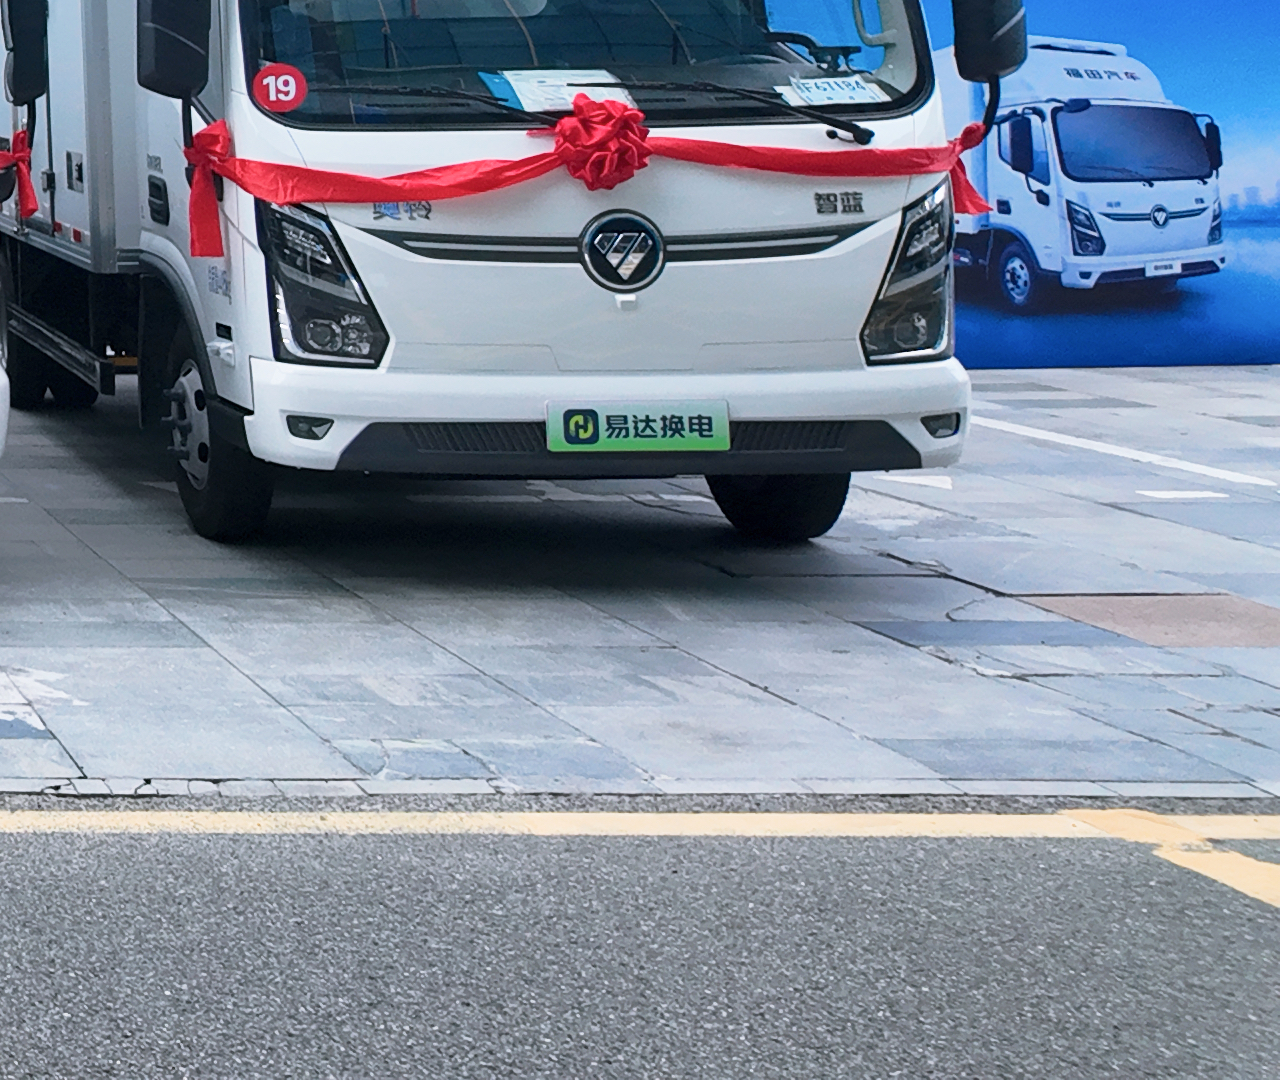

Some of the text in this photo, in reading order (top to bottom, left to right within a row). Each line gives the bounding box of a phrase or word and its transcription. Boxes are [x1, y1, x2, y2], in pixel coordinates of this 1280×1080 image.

[262, 74, 297, 102] 19
[814, 191, 865, 215] 智蓝
[605, 414, 714, 439] 易达换电
